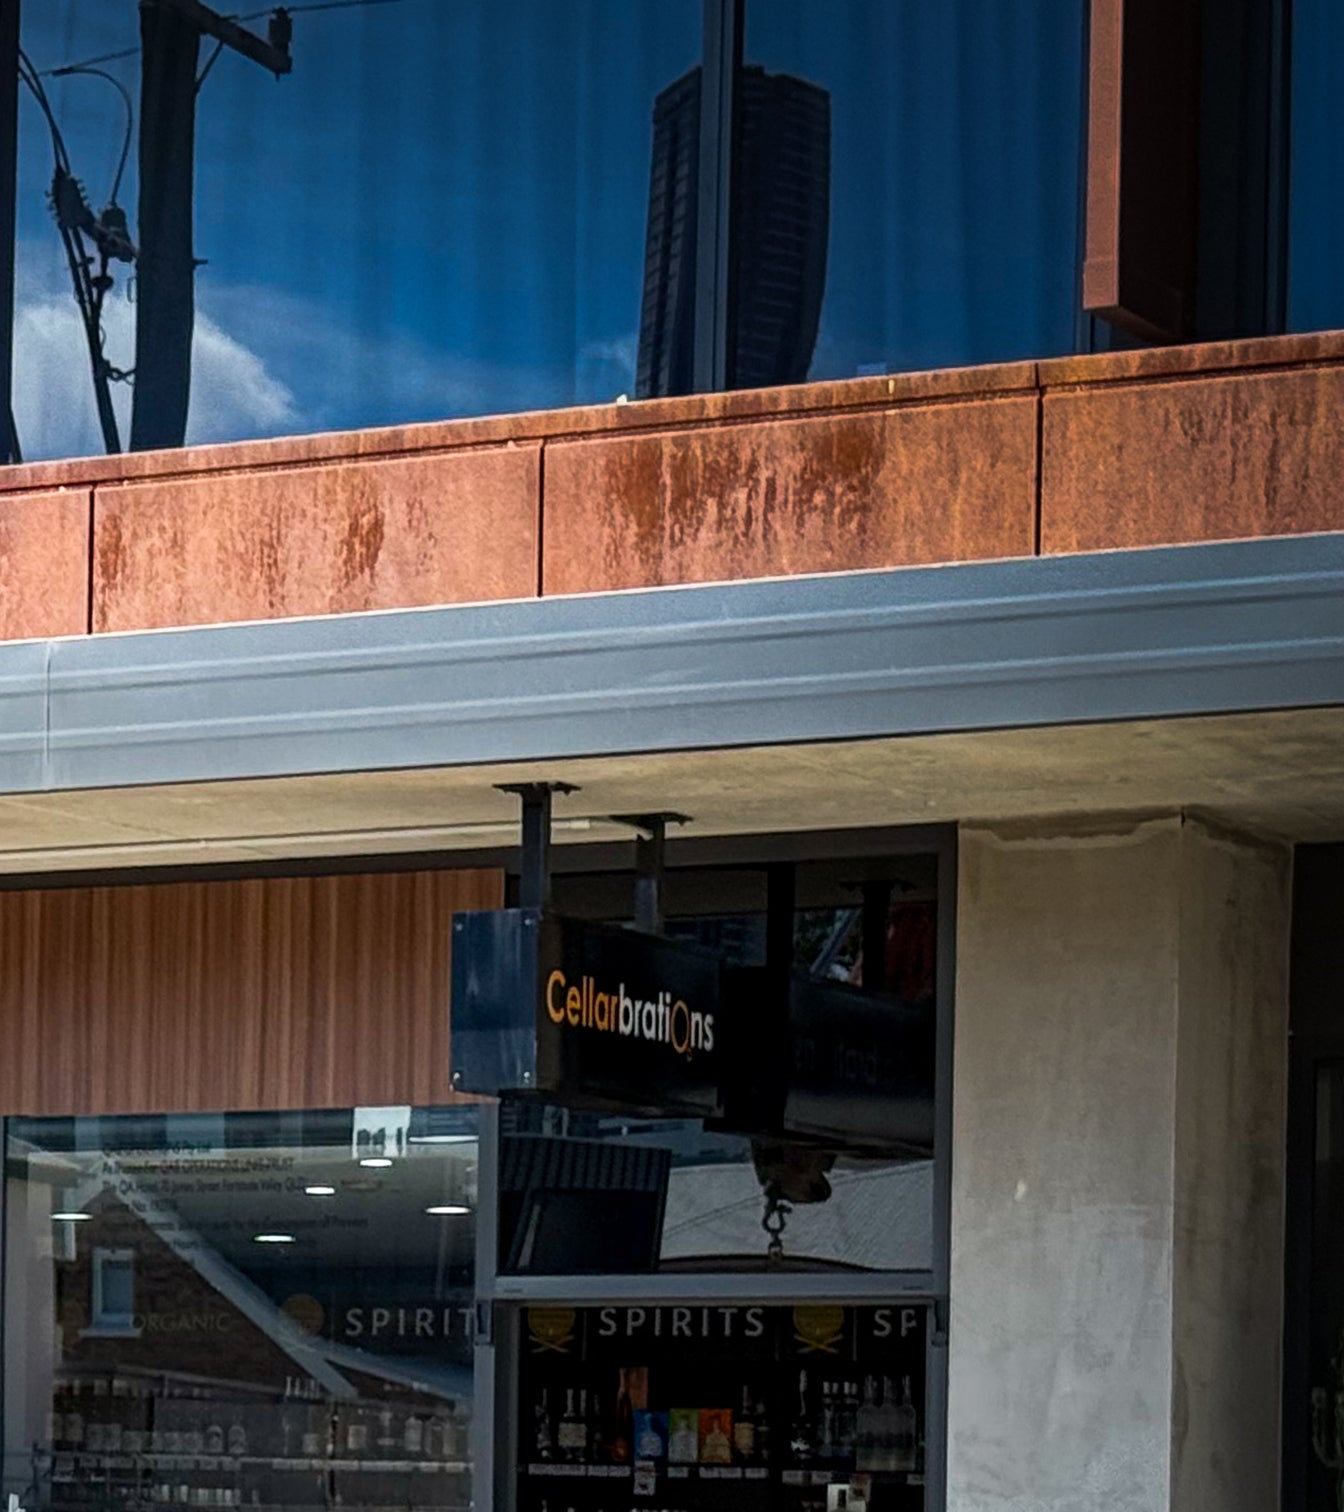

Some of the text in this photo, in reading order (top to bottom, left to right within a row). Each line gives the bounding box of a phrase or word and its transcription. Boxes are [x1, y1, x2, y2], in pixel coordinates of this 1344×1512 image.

[547, 970, 714, 1055] Cellarbrations
[133, 1313, 229, 1332] ORGANIC
[598, 1307, 765, 1336] SPIRITS
